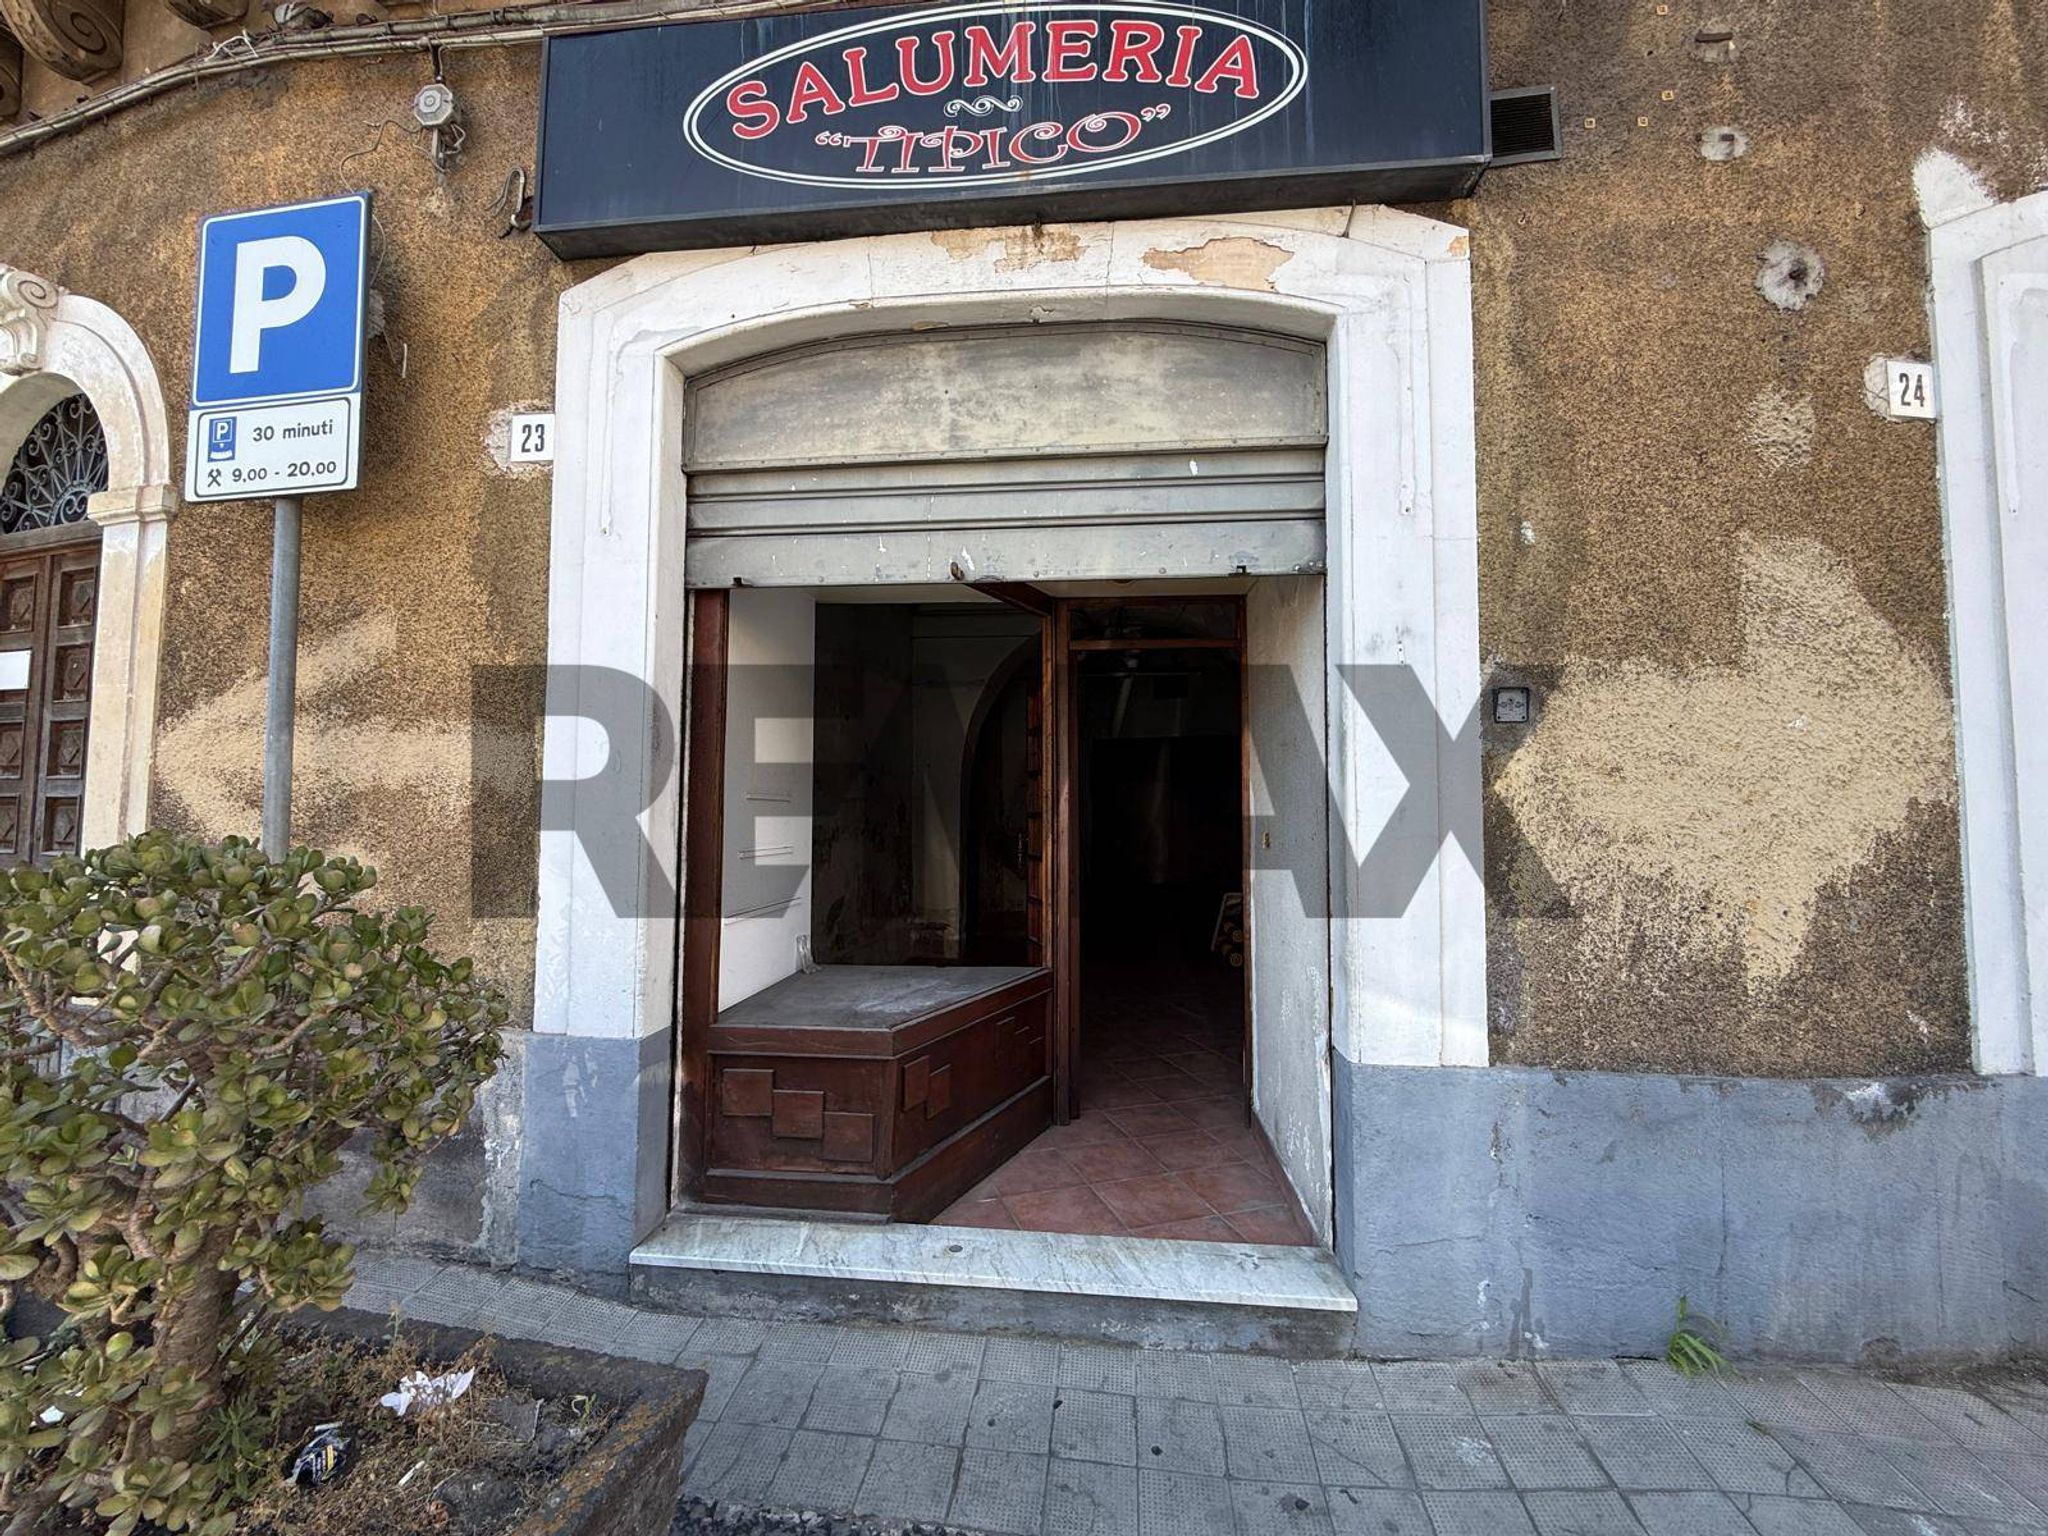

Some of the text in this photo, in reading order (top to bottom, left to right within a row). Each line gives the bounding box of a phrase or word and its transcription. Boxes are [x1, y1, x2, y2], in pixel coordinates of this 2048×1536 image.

[726, 19, 1259, 139] SALUMERIA
[229, 235, 327, 374] P
[1899, 372, 1925, 407] 24
[252, 419, 333, 442] 30 minuti
[521, 423, 545, 453] 23
